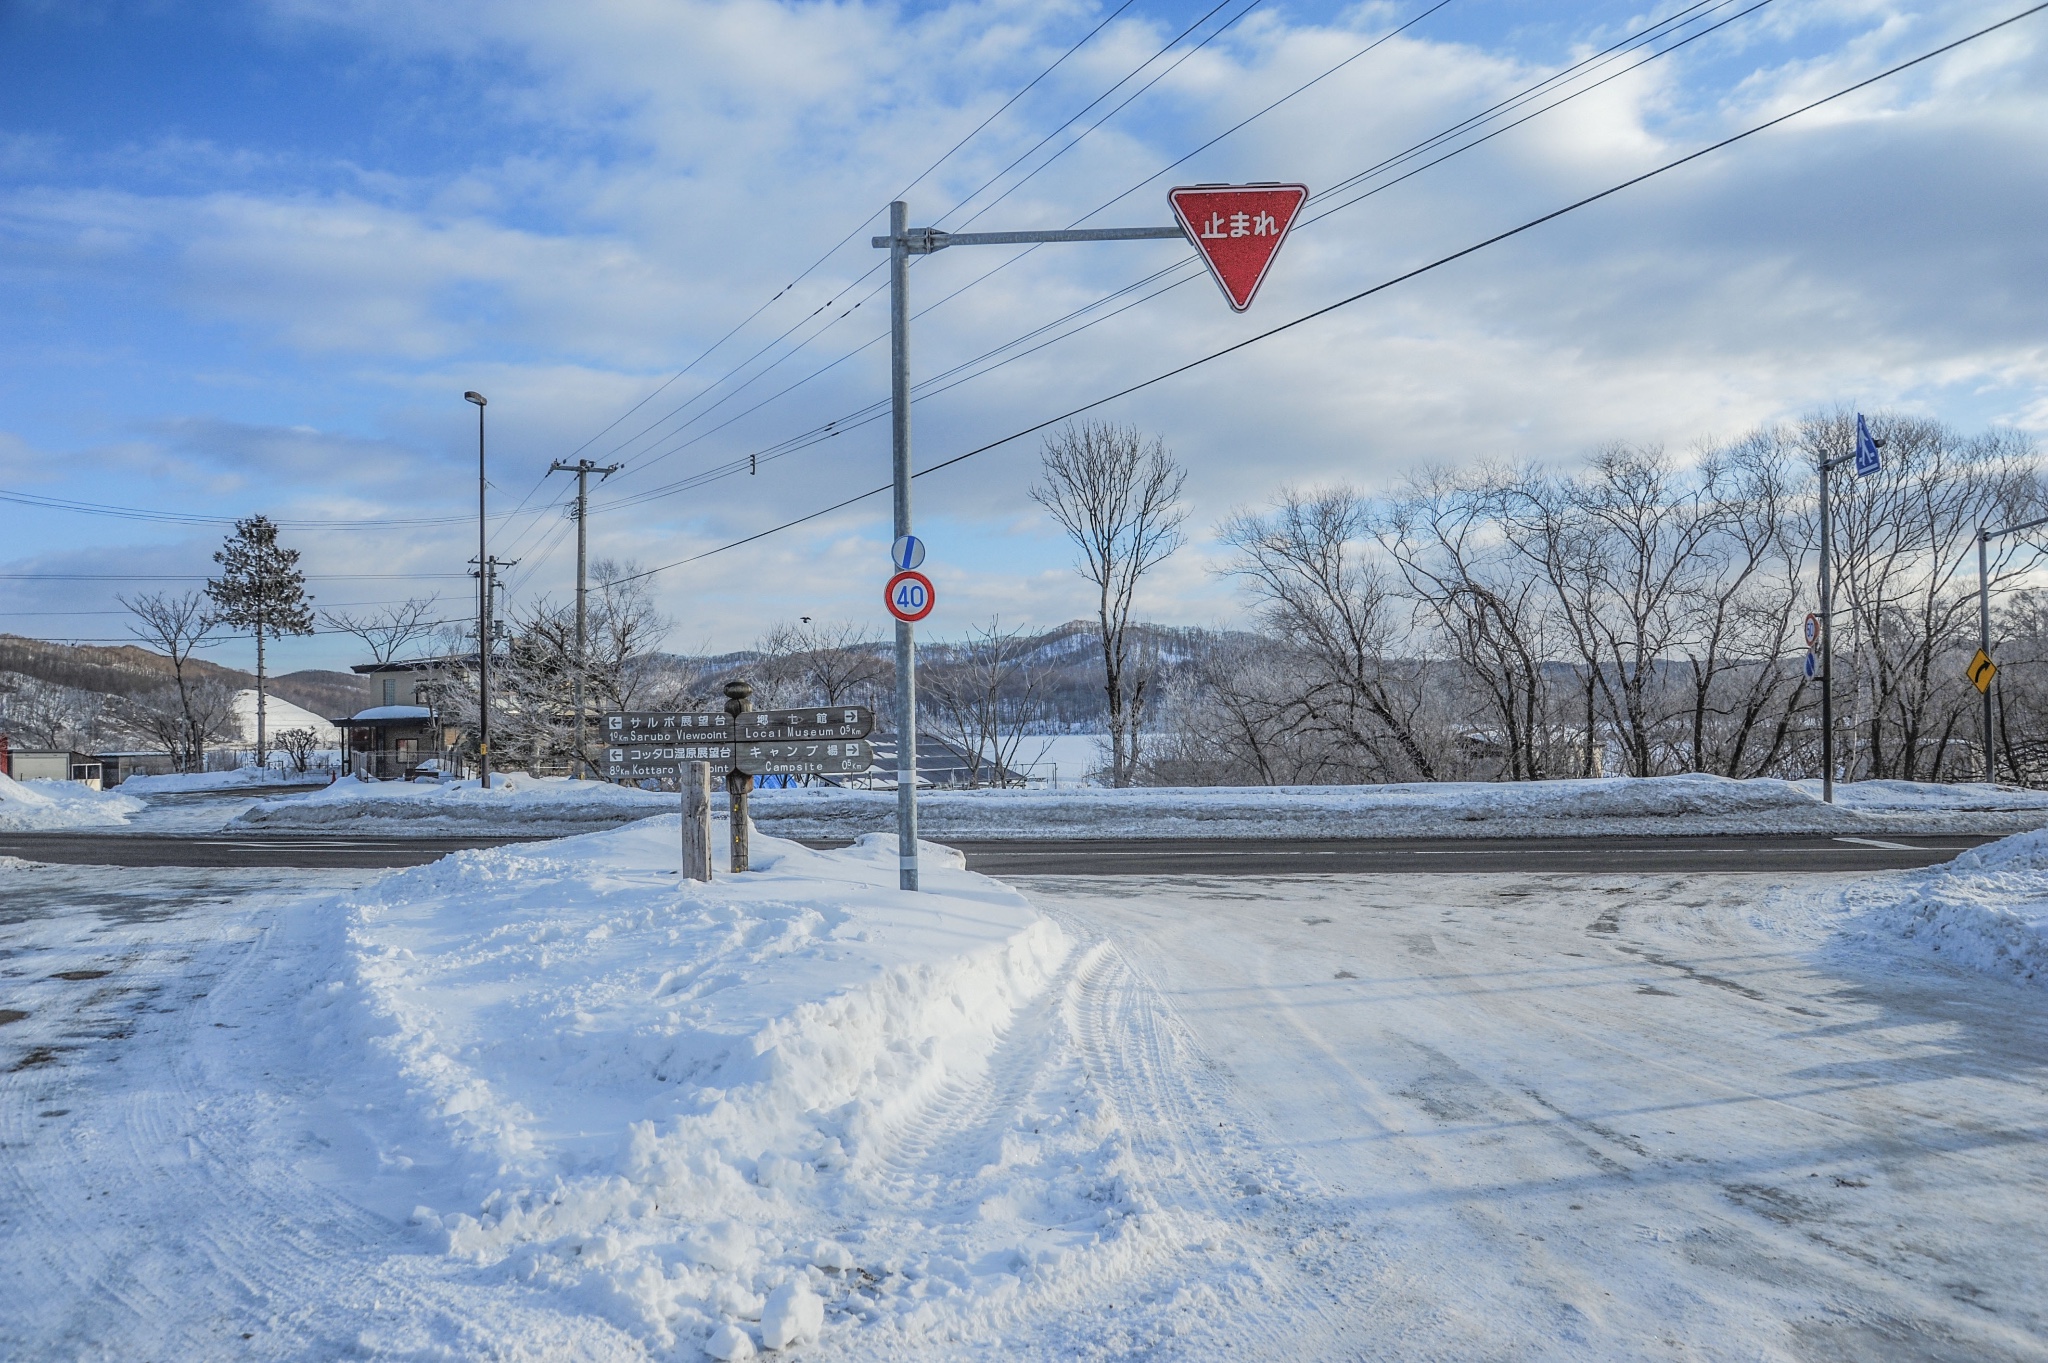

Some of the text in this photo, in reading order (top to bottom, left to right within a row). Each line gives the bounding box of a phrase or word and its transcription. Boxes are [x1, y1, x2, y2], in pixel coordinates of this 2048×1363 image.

[1200, 210, 1280, 239] 止まれ
[896, 585, 924, 608] 40
[630, 715, 726, 729] サルボ展望台
[630, 730, 671, 741] Sarubo
[676, 729, 728, 741] Viewpoint
[745, 728, 781, 739] Local
[787, 726, 834, 737] Museum
[631, 746, 731, 760] コッタロ湿原展望台
[750, 744, 838, 758] キャンプ場
[632, 764, 674, 775] Kottaro
[765, 760, 823, 772] Campsite
